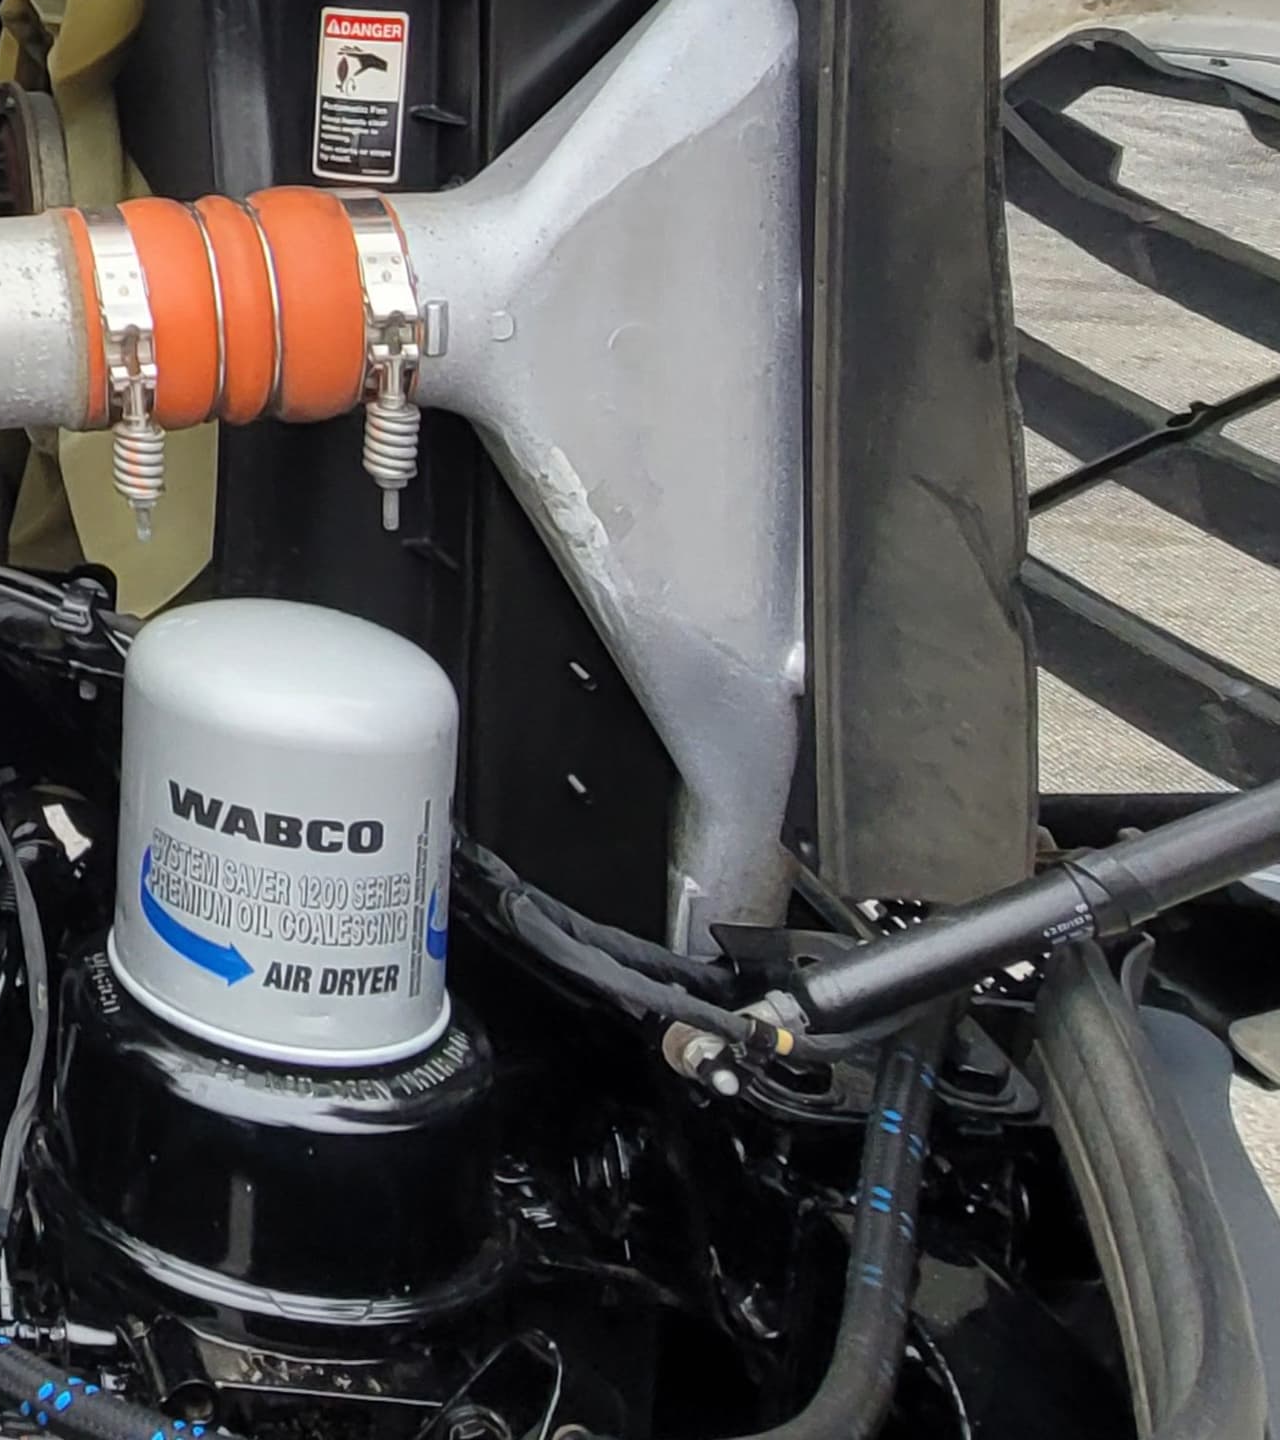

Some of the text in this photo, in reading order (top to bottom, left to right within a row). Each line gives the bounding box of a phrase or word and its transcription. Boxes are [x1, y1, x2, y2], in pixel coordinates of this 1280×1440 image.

[340, 21, 401, 39] DANGER
[168, 779, 384, 855] WABCO
[147, 862, 409, 948] PREMIUM OIL COALESCING
[151, 827, 411, 912] SYSTEM SAVER 1200 SERIES
[262, 961, 401, 997] AIR DRYER
